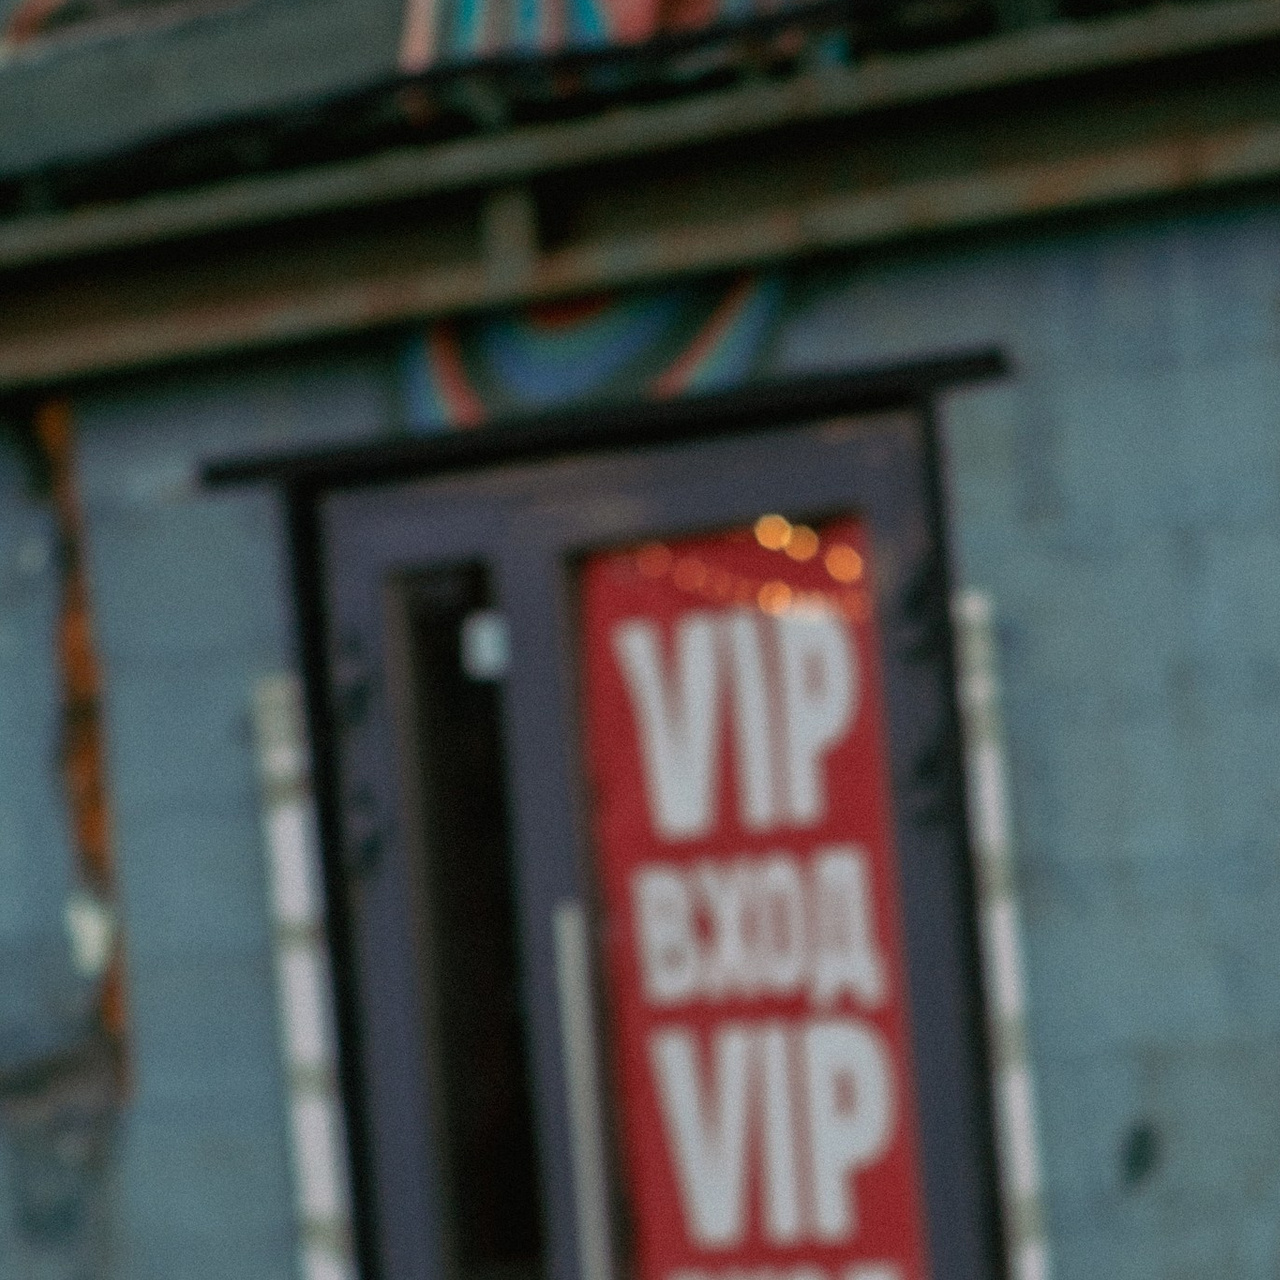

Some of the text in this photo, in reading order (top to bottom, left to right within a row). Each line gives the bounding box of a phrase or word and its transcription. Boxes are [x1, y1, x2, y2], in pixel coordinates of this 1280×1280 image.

[611, 600, 857, 838] VIP
[633, 848, 883, 1008] ВХОД
[648, 1020, 893, 1246] VIP
